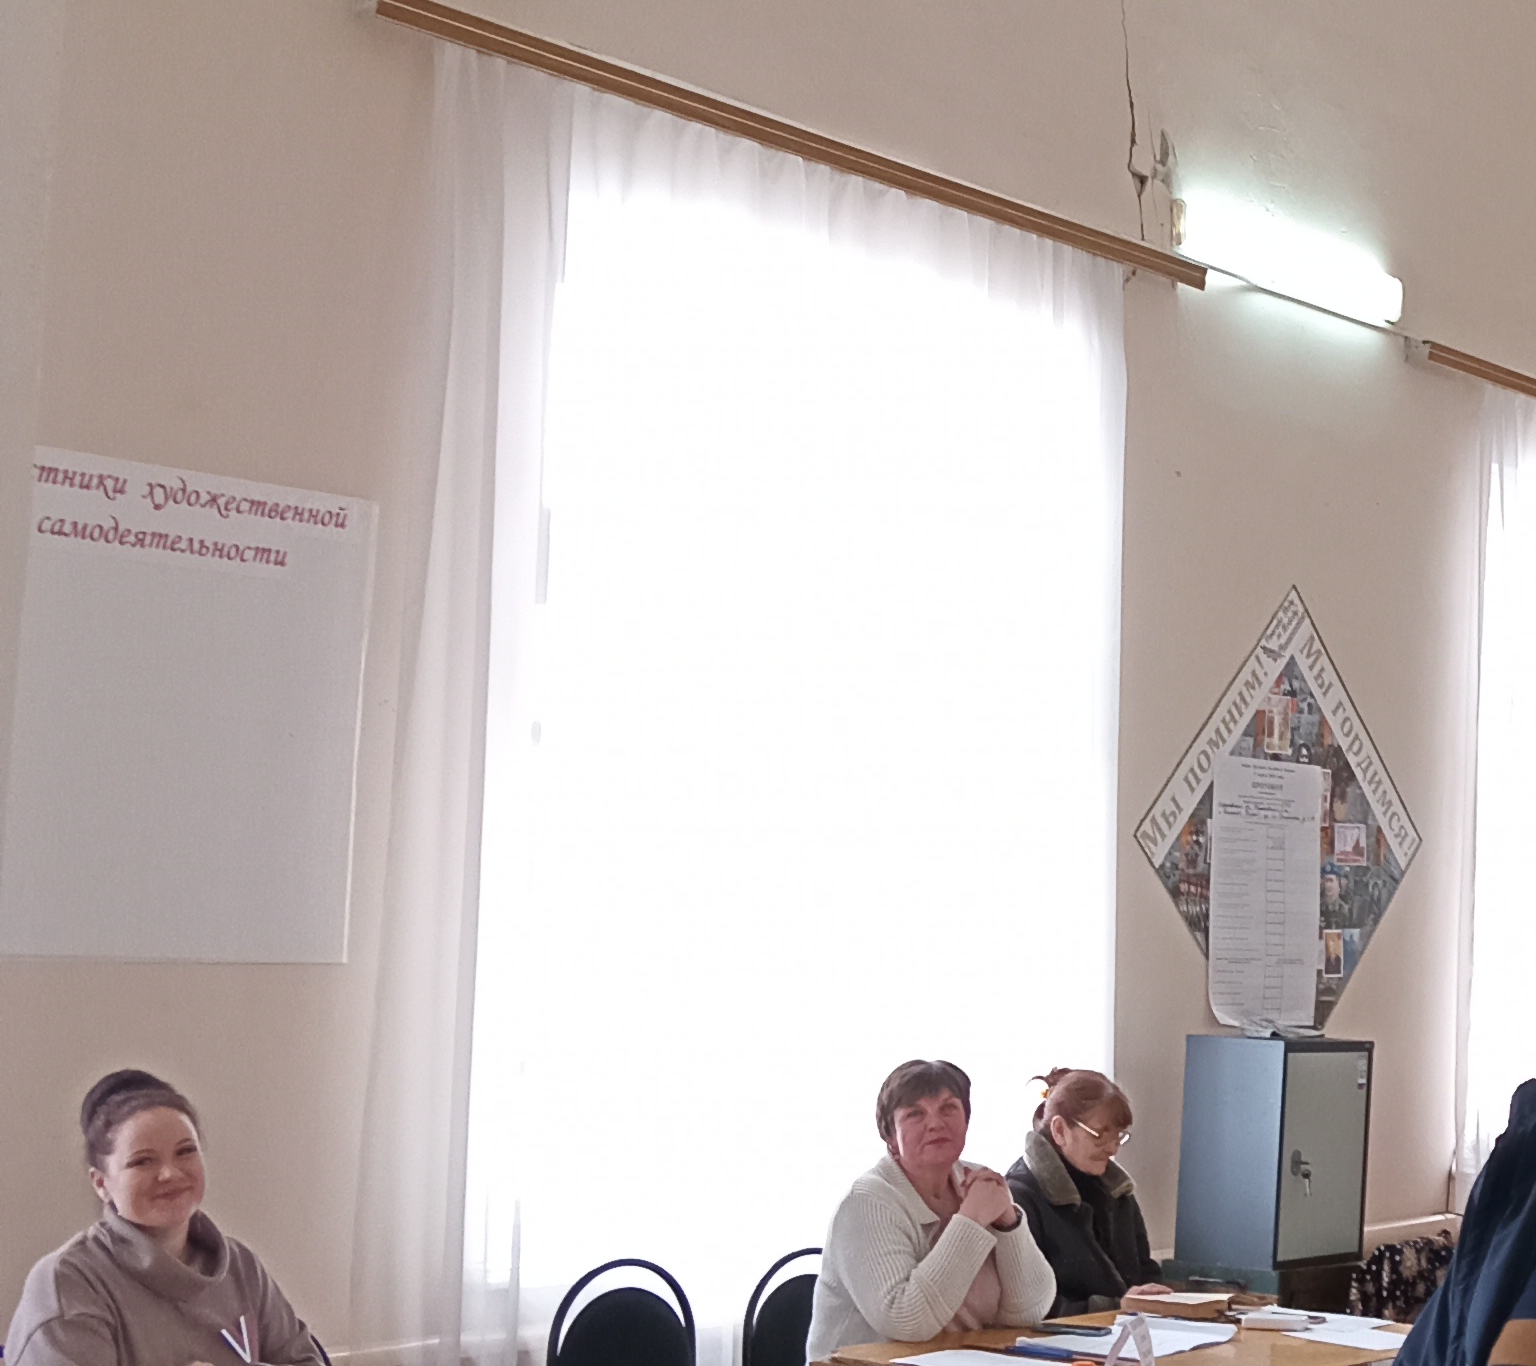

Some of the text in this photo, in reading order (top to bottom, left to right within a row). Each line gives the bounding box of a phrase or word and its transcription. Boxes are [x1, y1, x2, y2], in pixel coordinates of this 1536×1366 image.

[34, 463, 348, 530] тники художественной
[37, 515, 288, 567] самодеятельности
[1300, 632, 1334, 699] Мы
[1138, 793, 1184, 859] Мы
